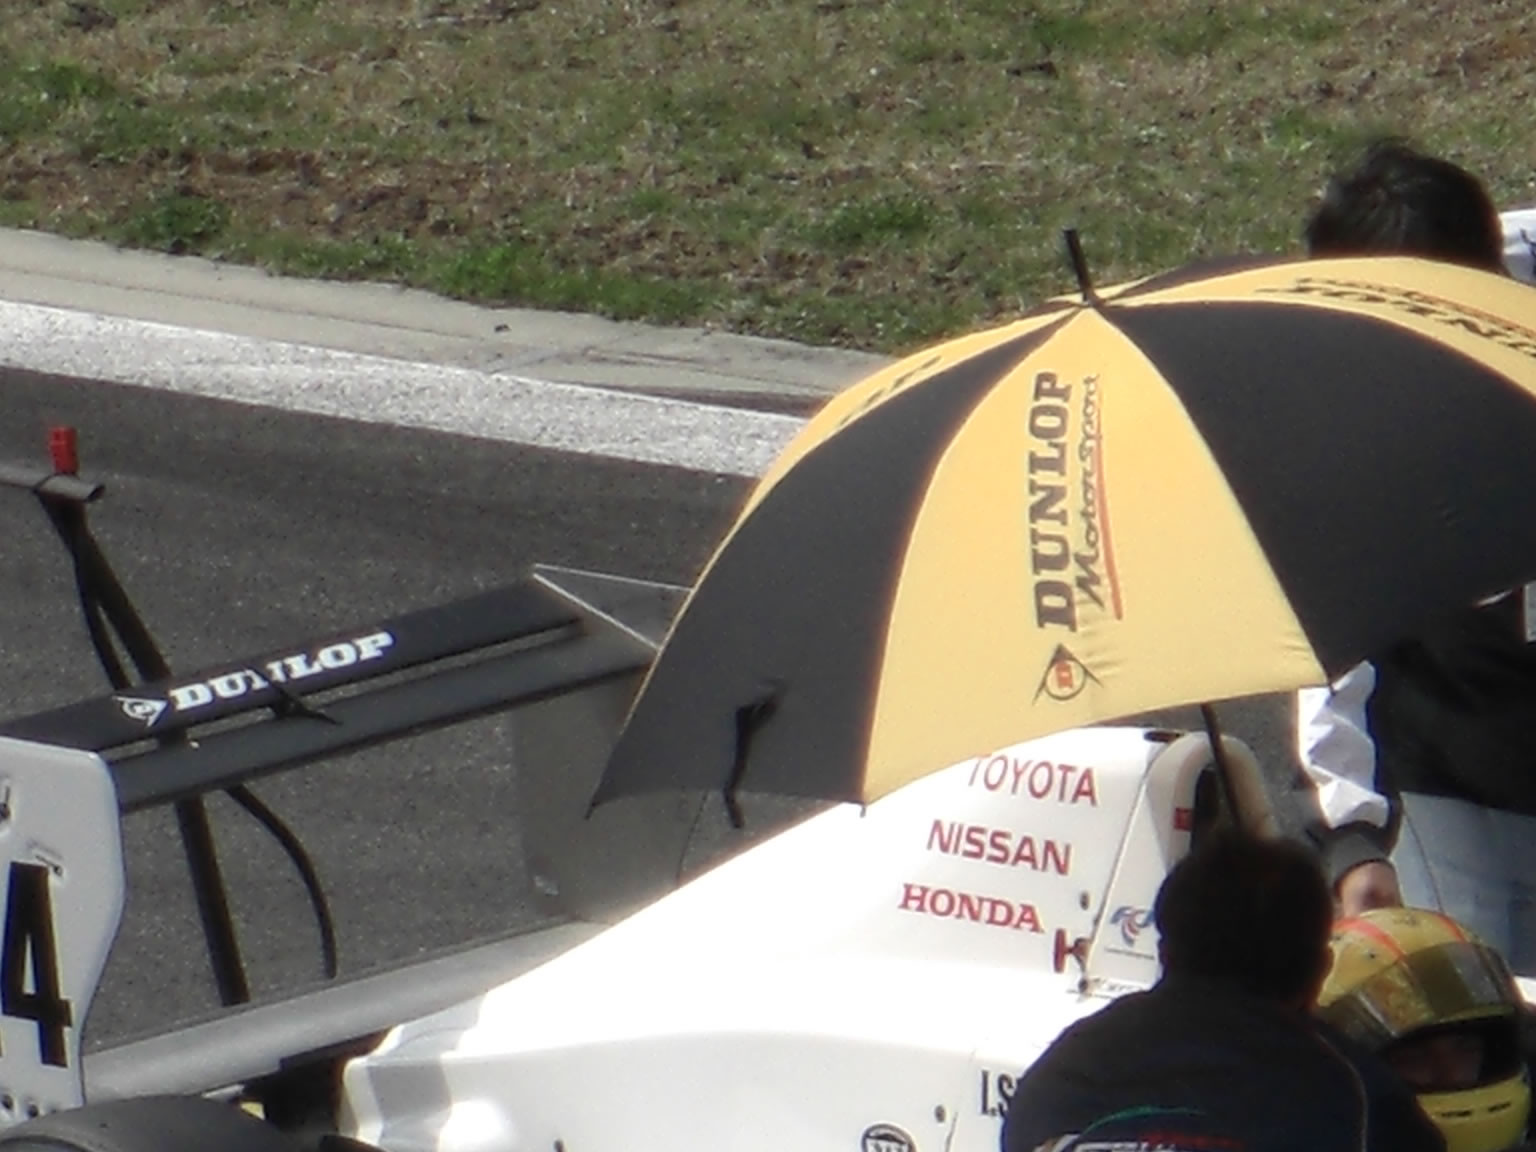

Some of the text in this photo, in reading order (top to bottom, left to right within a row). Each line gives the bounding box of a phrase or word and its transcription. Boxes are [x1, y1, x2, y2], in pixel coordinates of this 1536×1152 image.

[1028, 370, 1078, 633] DUNLOP
[168, 631, 394, 711] DUNLOP
[967, 752, 1098, 807] TOYOTA
[926, 818, 1072, 876] NISSAN
[897, 882, 1046, 934] HONDA
[0, 861, 72, 1068] 4
